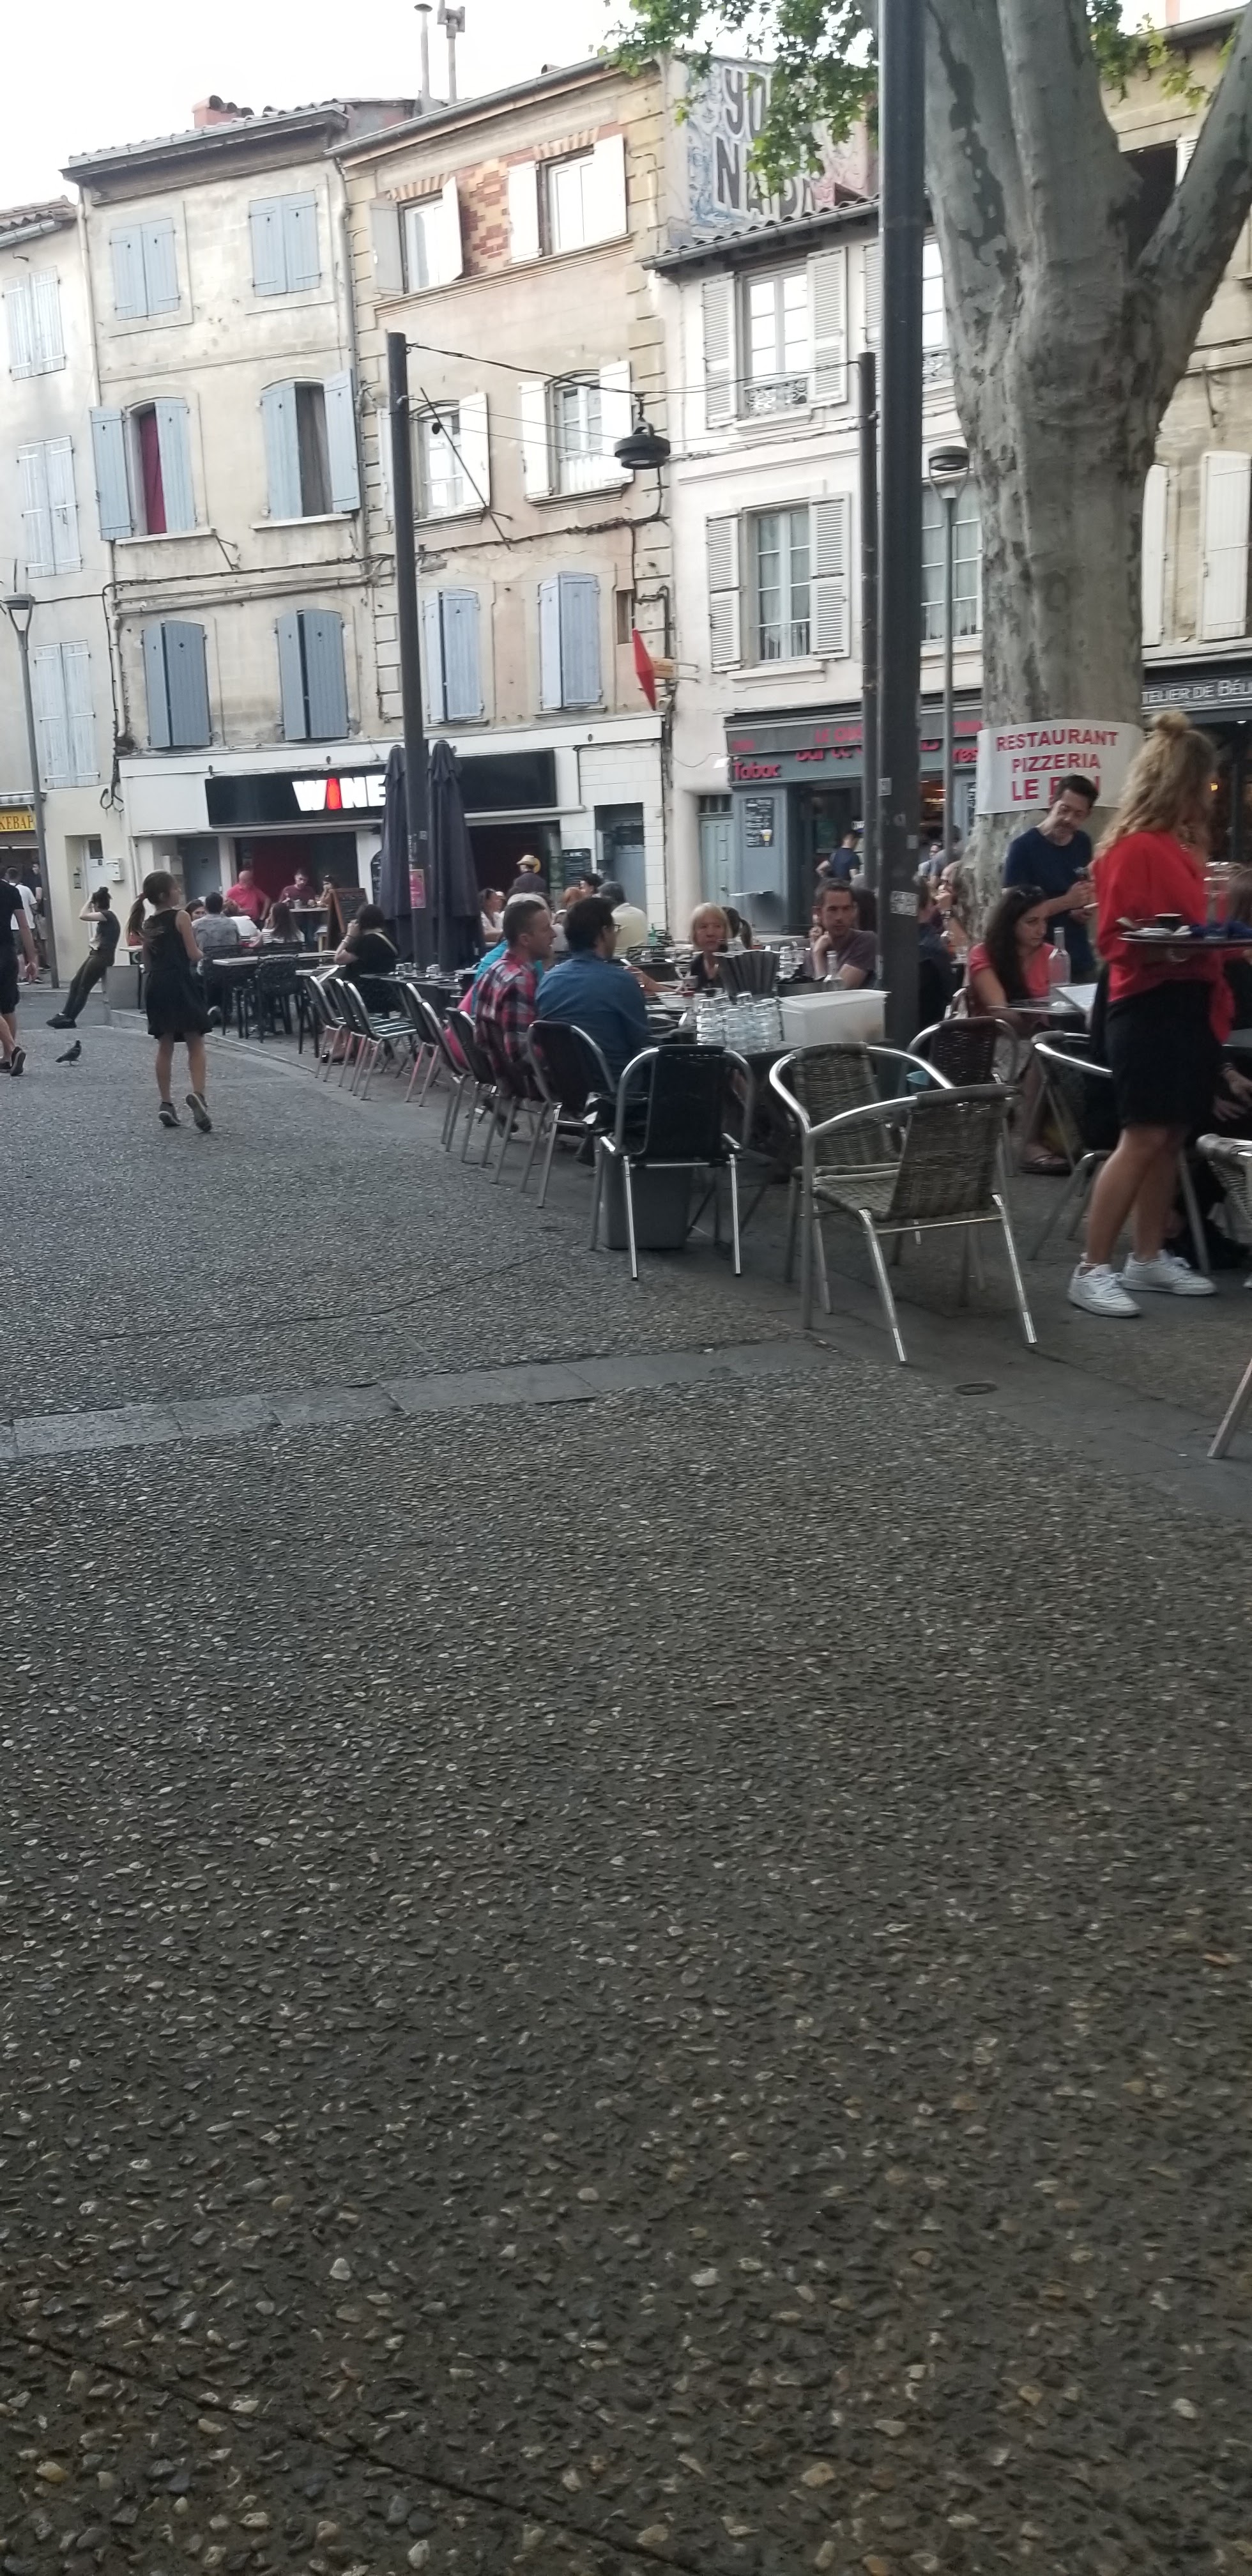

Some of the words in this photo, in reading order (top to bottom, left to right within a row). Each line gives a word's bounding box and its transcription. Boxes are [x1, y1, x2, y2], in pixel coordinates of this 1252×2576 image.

[1193, 686, 1214, 698] DE
[996, 728, 1117, 752] RESTAURANT
[733, 762, 781, 780] Tabac
[1012, 753, 1101, 774] PIZZERIA
[292, 774, 386, 811] WINE
[1012, 778, 1039, 801] LE
